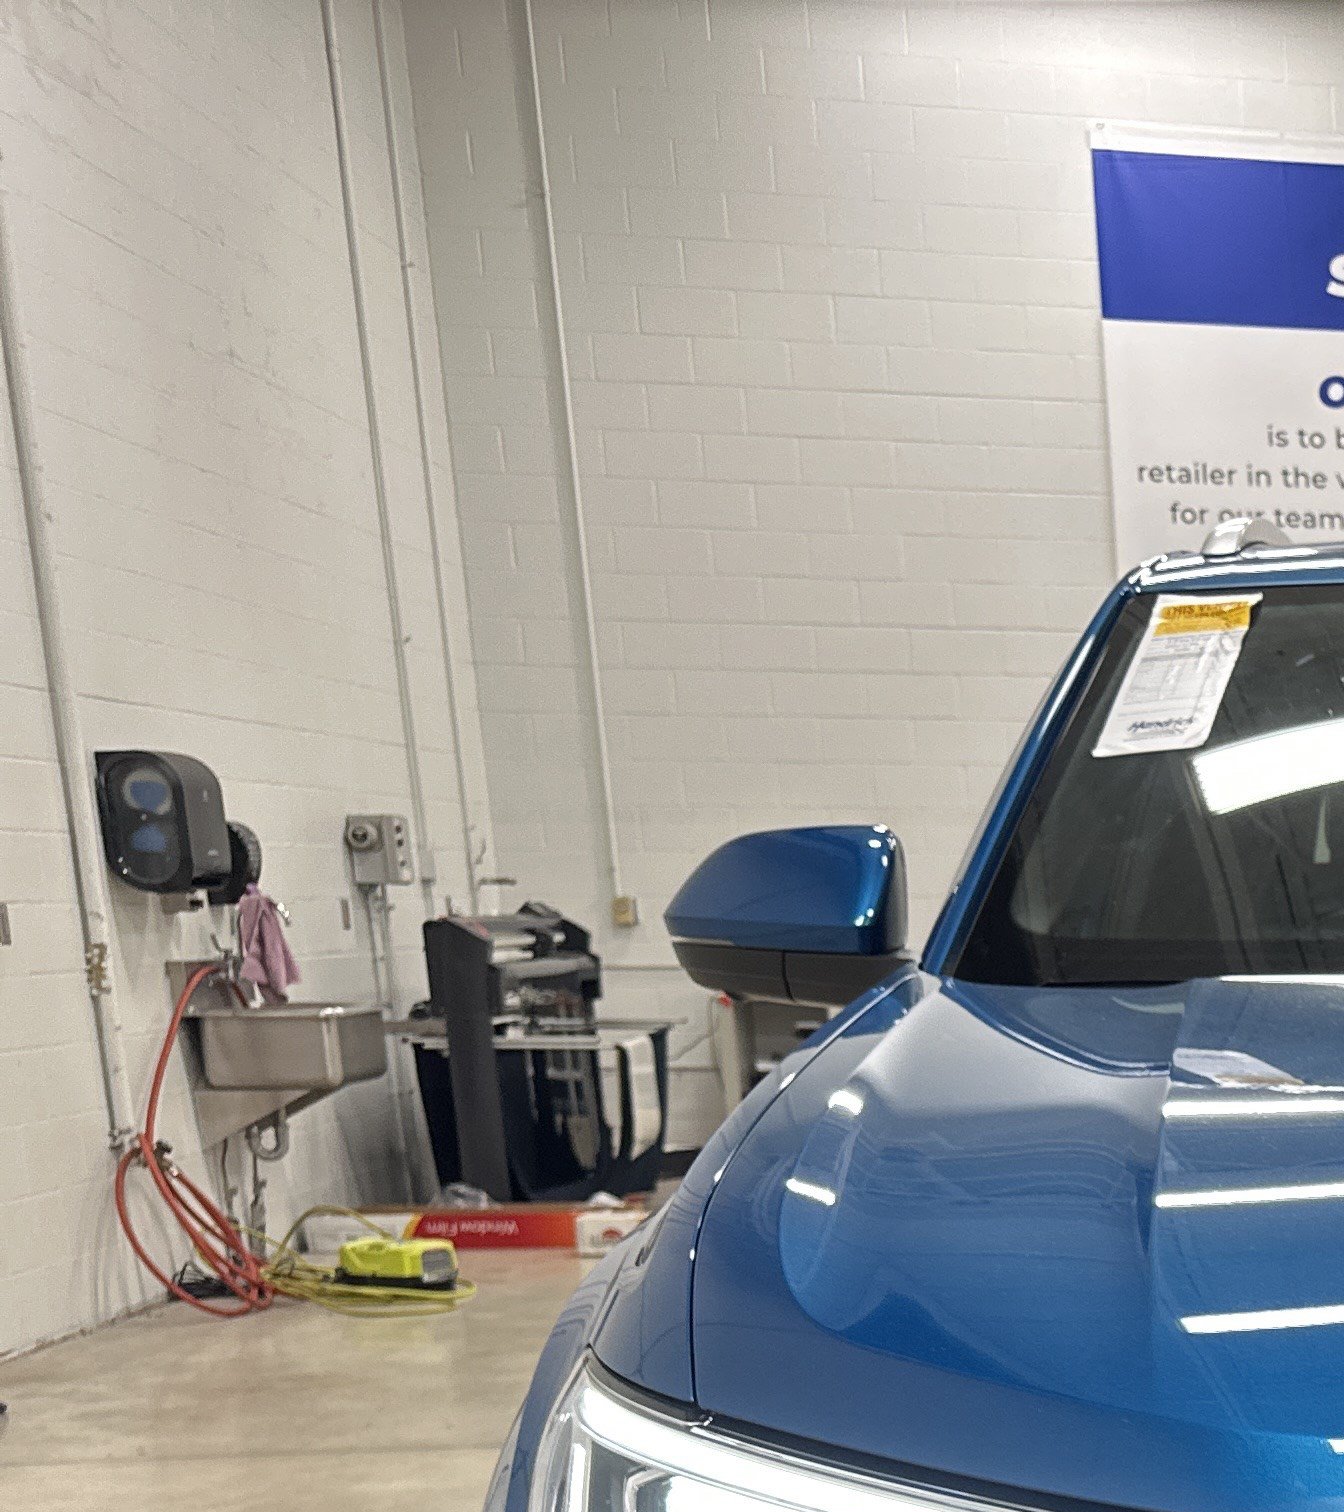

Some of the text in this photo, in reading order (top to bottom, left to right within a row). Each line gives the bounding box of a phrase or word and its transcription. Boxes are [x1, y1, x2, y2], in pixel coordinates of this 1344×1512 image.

[1266, 424, 1289, 448] is
[1297, 429, 1326, 450] to
[1136, 461, 1236, 487] retailer
[1246, 464, 1273, 488] in
[1281, 466, 1328, 490] the
[1169, 502, 1209, 525] for
